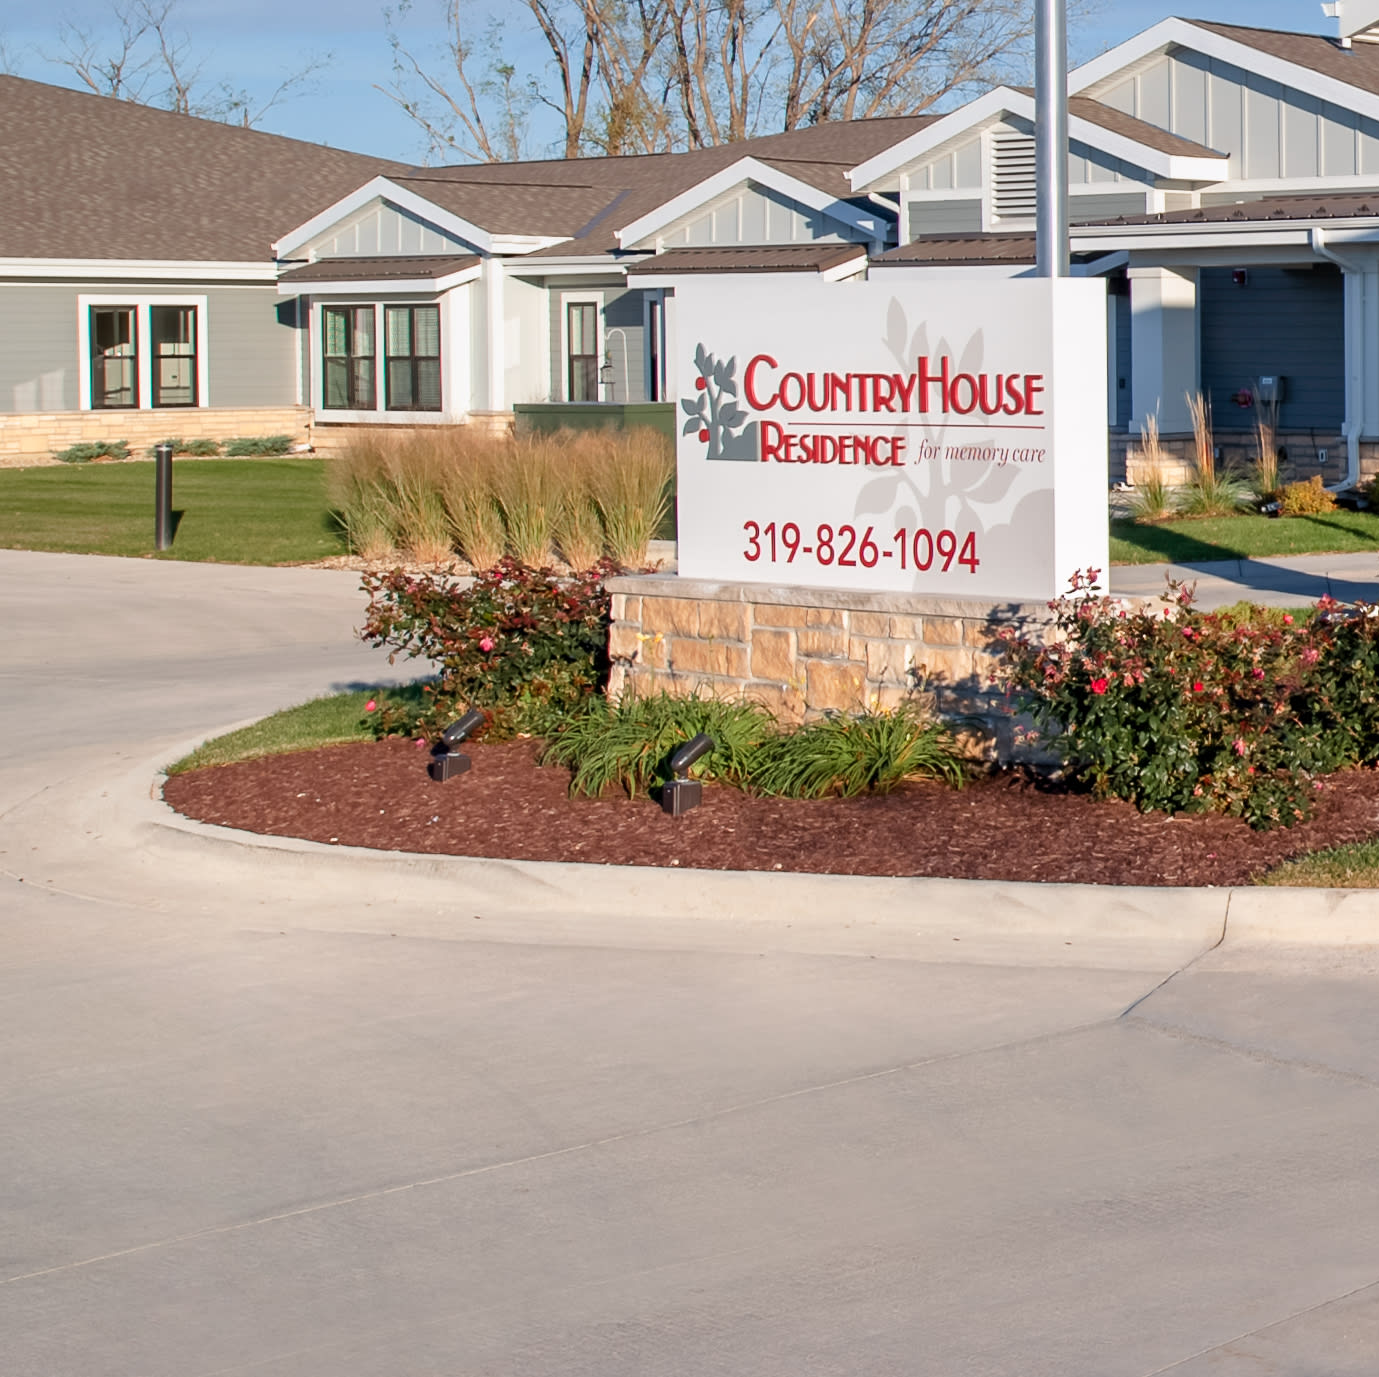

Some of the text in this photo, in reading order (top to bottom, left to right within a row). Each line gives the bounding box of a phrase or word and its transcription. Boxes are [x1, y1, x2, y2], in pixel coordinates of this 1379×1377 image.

[914, 439, 1046, 467] for memory care
[743, 520, 980, 574] 319-826-1094
